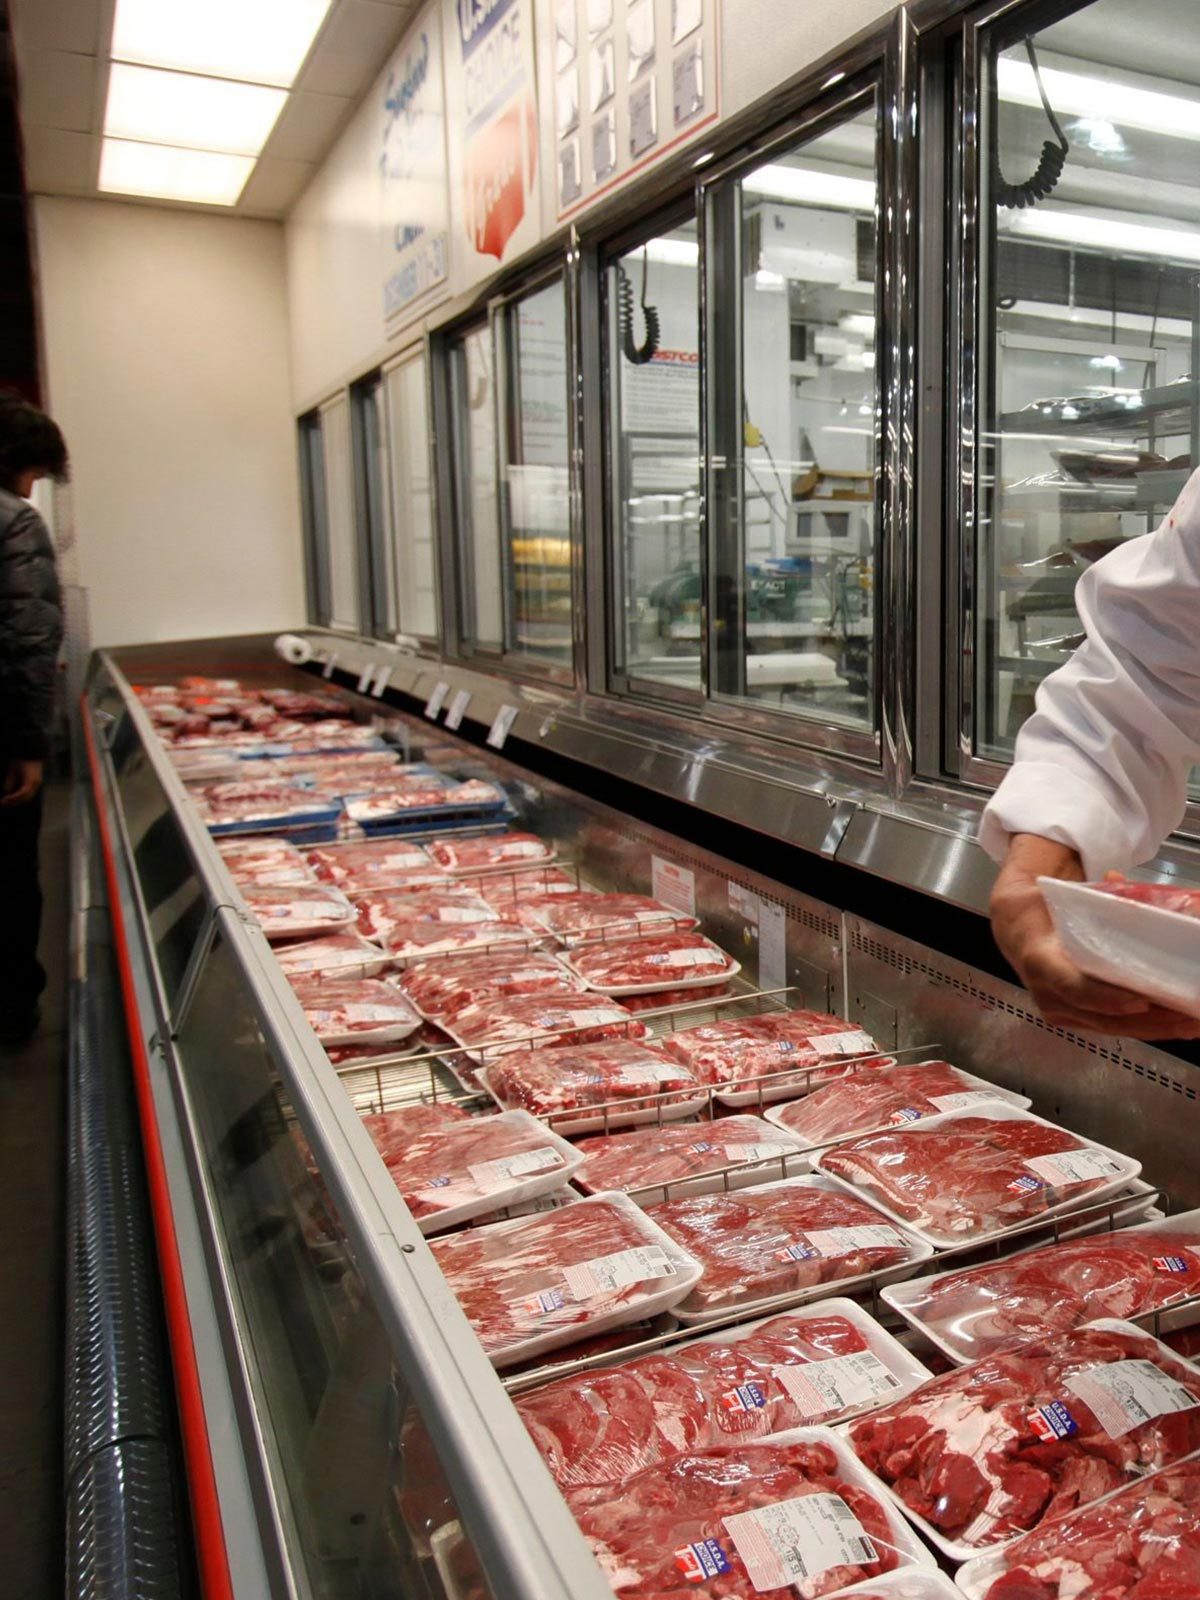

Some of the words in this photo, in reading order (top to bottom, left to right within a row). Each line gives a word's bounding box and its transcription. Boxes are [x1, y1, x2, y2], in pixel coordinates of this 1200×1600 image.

[1044, 1406, 1063, 1432] CHOICE
[1051, 1401, 1072, 1430] U.S.D.A.
[697, 1543, 715, 1572] CHOICE
[706, 1539, 725, 1570] U.S.D.A.
